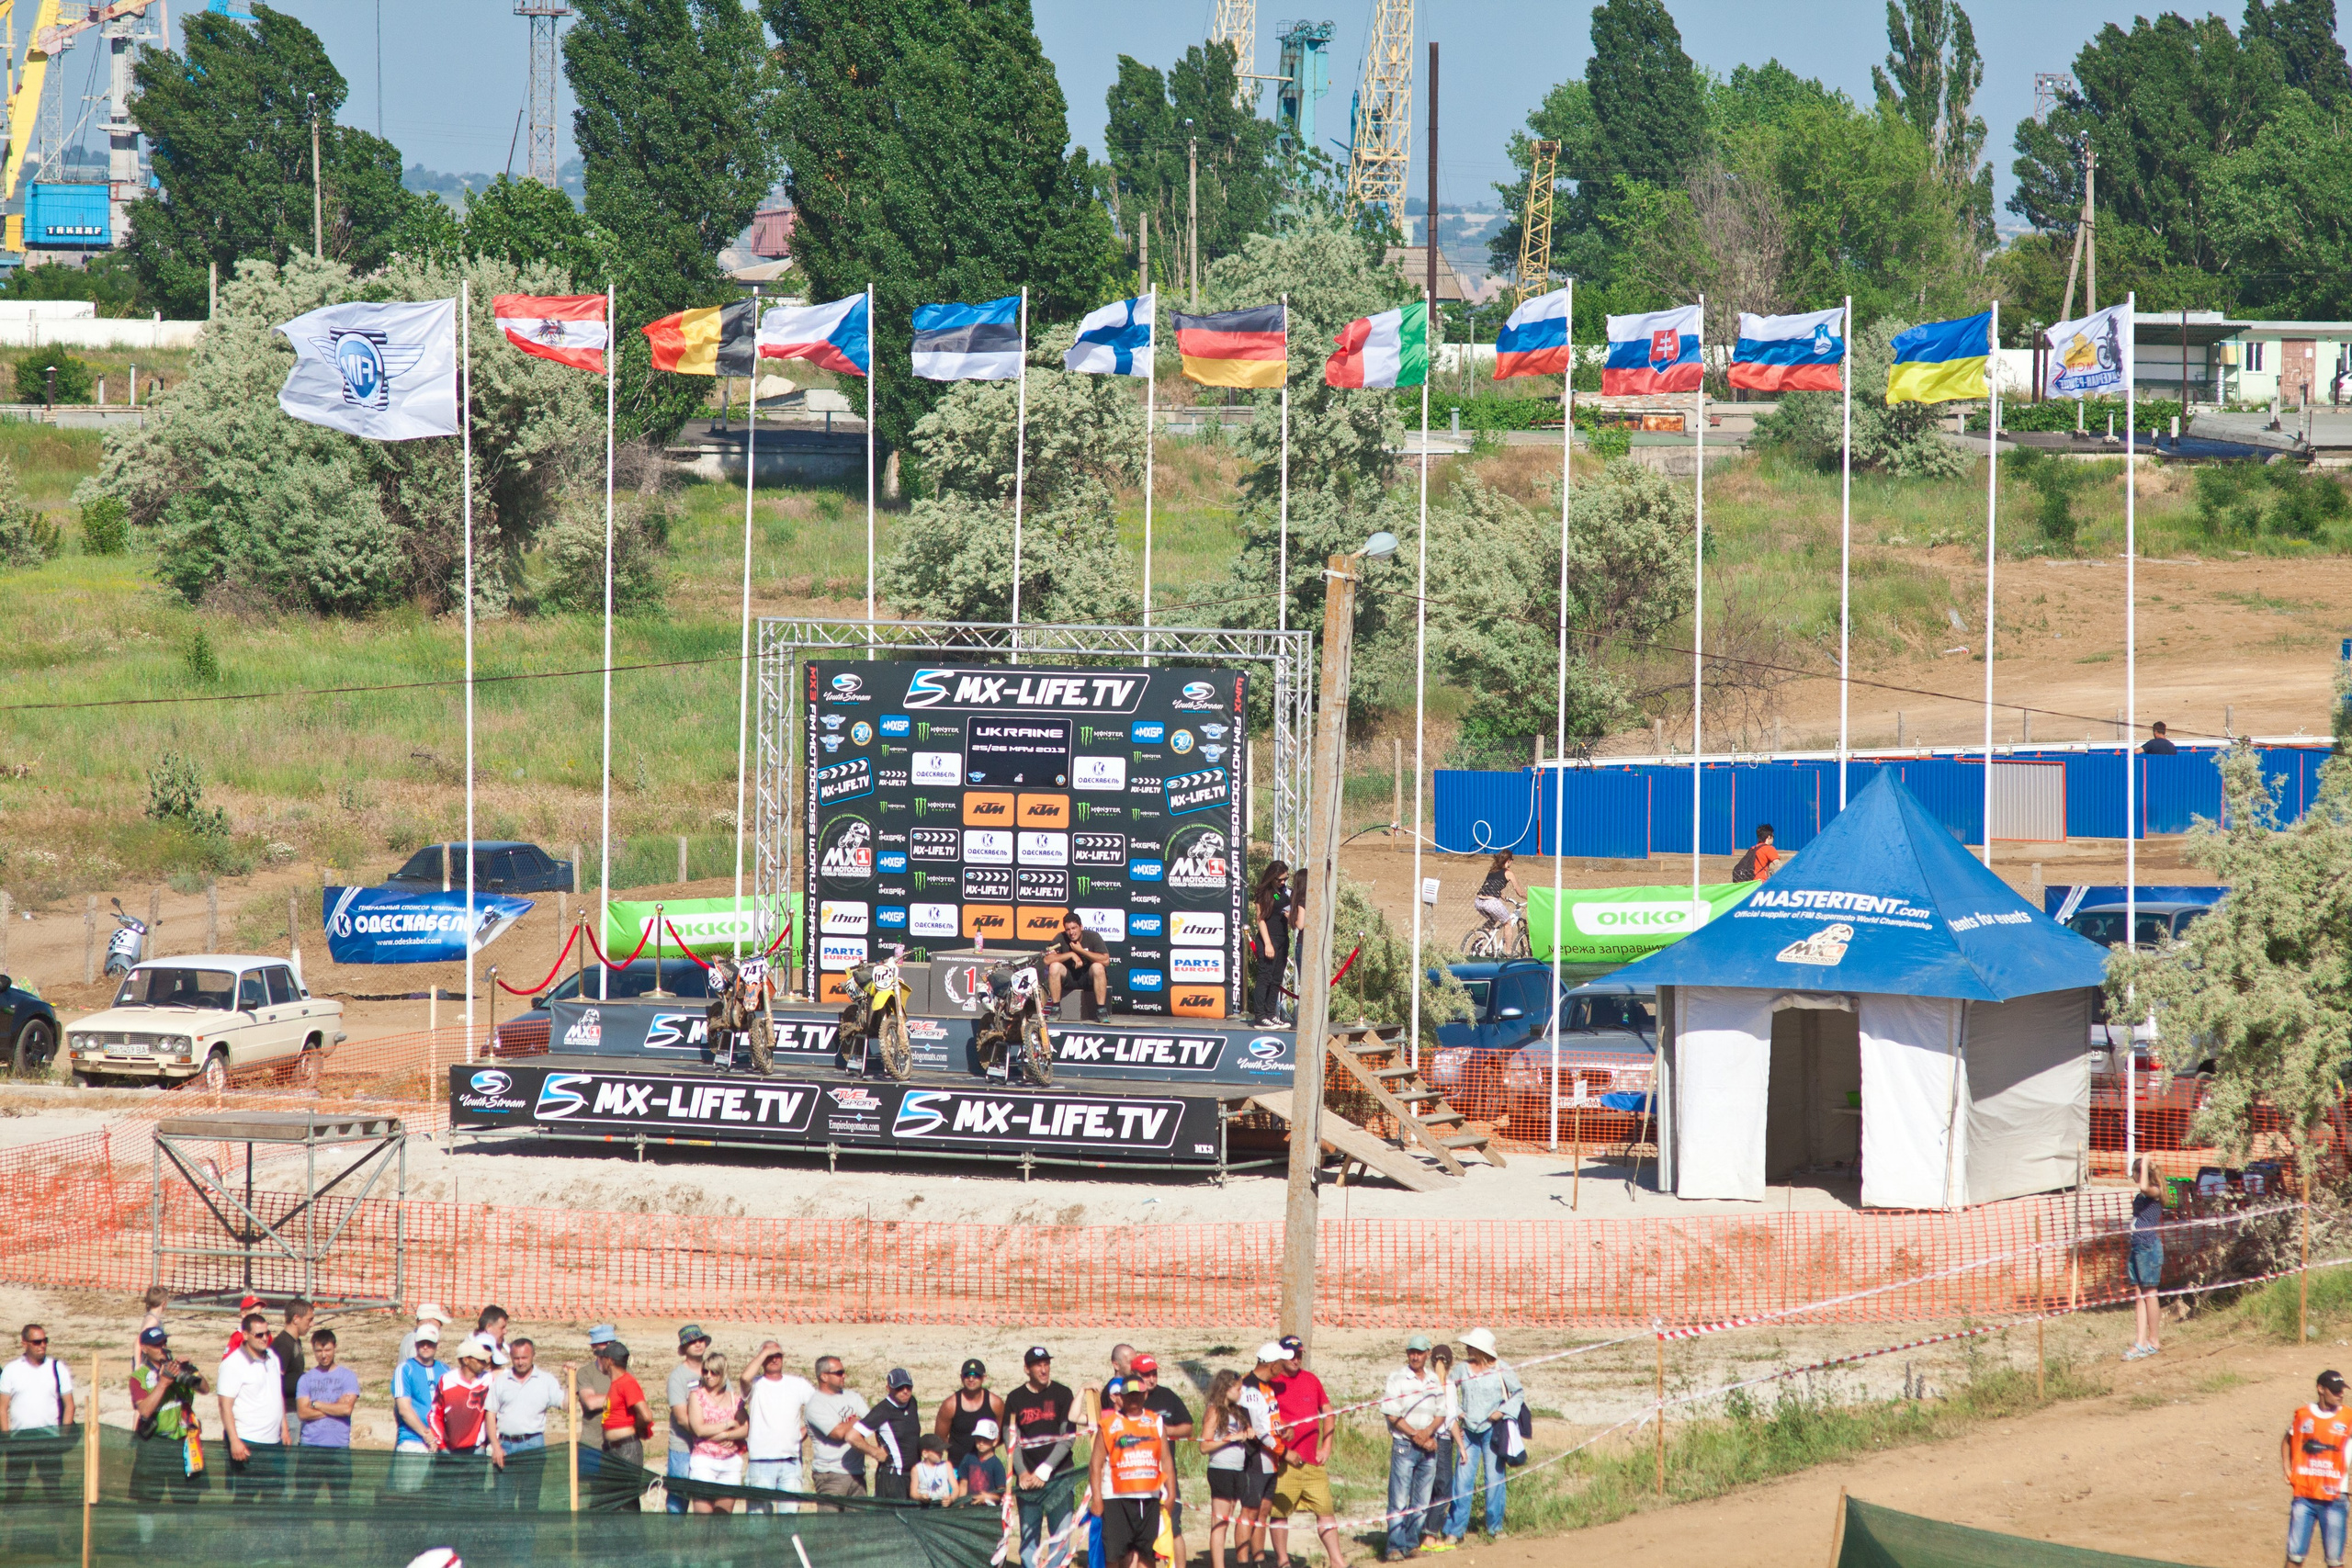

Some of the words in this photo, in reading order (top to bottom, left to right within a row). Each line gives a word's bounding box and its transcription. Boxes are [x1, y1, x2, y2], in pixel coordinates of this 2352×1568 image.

[954, 676, 1136, 706] MX-LIFE.TV
[886, 720, 909, 731] MXGP
[1233, 716, 1242, 742] FIM
[976, 727, 1064, 739] UKRAINE
[1139, 728, 1163, 739] MXGP
[972, 744, 1007, 752] 25/26
[808, 732, 817, 835] MOTOCROSS
[821, 775, 870, 798] MX-LIFE.TV
[1170, 785, 1226, 808] MX-LIFE.TV
[1231, 745, 1240, 848] MOTOCROSS
[973, 802, 1006, 814] KTM
[1027, 804, 1060, 816] KTM
[913, 845, 956, 855] MX-LIFE.TV
[1075, 851, 1121, 861] MX-LIFE.TV
[822, 847, 871, 866] MX1
[884, 857, 905, 868] MXGP
[1137, 865, 1161, 875] MXGP
[1169, 858, 1226, 876] MX1
[1231, 851, 1240, 908] WORLD
[966, 886, 1009, 895] MX-LIFE.TV
[1020, 886, 1064, 897] MX-LIFE.TV
[831, 913, 867, 924] thor
[883, 911, 905, 922] MXGP
[972, 915, 1005, 928] KTM
[1597, 910, 1686, 925] OKKO
[1734, 910, 1760, 919] Official
[1760, 910, 1792, 919] supplier
[1815, 912, 1855, 921] Supermoto
[1857, 915, 1878, 923] World
[1880, 917, 1932, 931] Championship
[1948, 916, 1980, 931] tents
[1974, 912, 1996, 926] for
[1994, 910, 2032, 924] events
[1027, 917, 1059, 929] KTM
[1136, 919, 1160, 931] MXGP
[1182, 924, 1224, 934] thor
[376, 937, 442, 946] www.odeskabel.com
[808, 897, 816, 1003] CHAMPIONSHI
[824, 947, 864, 955] PARTS
[1231, 909, 1240, 1014] CHAMPIONSH
[964, 966, 976, 995] 1
[1018, 976, 1030, 990] 4
[1136, 975, 1161, 986] MXGP
[1179, 995, 1215, 1007] KTM
[564, 1025, 601, 1038] MX1
[1060, 1035, 1215, 1066] MX-LIFE.TV
[593, 1082, 804, 1122] MX-LIFE.TV
[829, 1120, 880, 1132] Empirelogomats.com
[953, 1100, 1169, 1140] MX-LIFE.TV
[1194, 1145, 1214, 1155] MX3
[1124, 1450, 1153, 1460] TRACK
